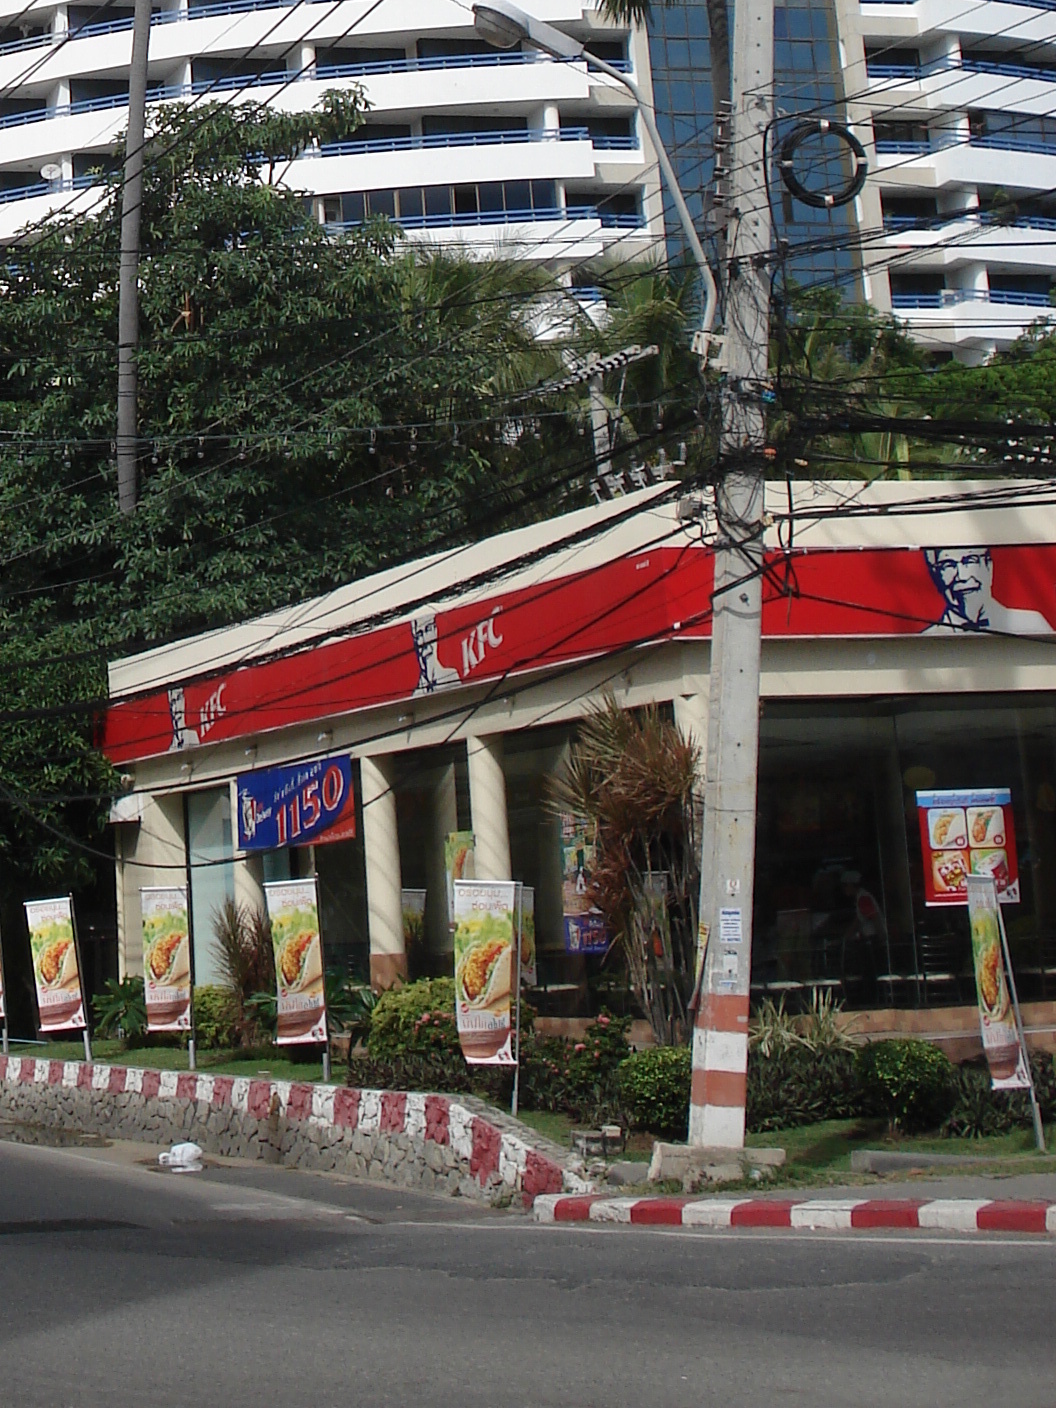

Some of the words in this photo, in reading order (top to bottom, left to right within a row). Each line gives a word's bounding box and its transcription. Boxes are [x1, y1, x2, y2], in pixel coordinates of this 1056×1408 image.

[461, 605, 504, 676] KFC
[200, 683, 227, 738] KFC
[276, 765, 344, 848] 1150
